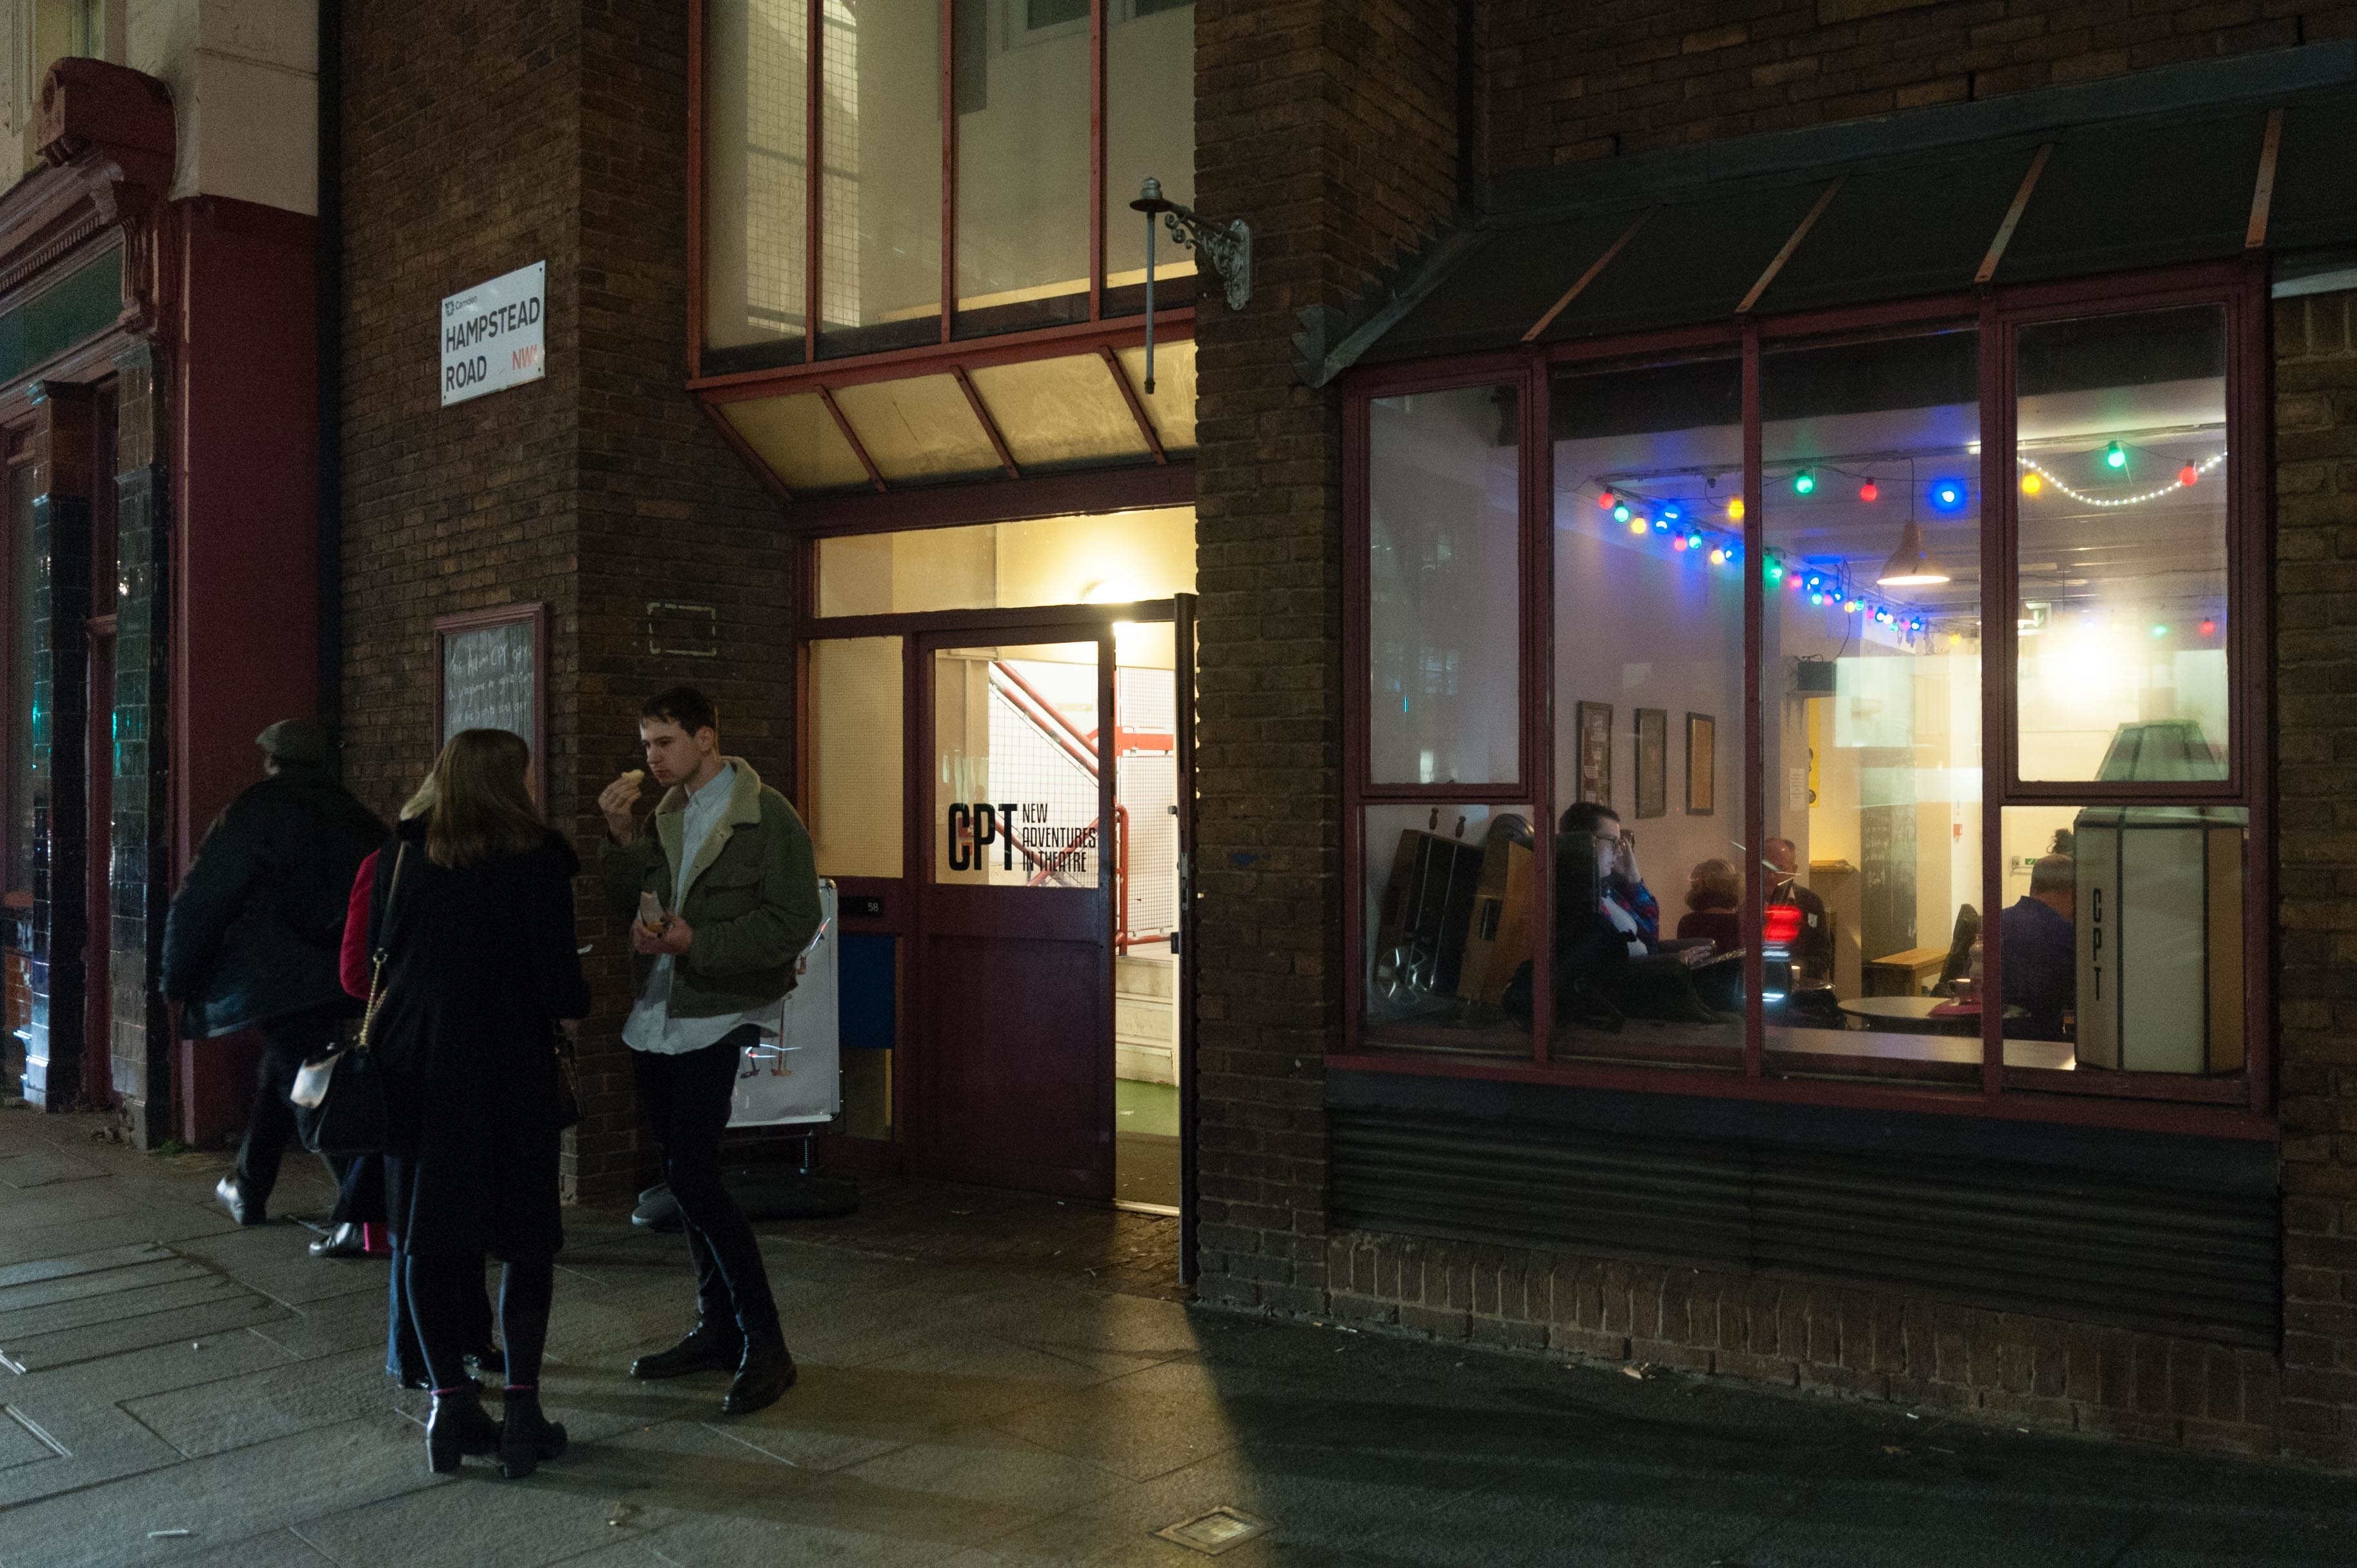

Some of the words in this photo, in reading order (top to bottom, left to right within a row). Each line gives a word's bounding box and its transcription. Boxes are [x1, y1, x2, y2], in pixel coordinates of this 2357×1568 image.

[455, 296, 478, 310] Camden
[446, 297, 540, 354] HAMPSTEAD
[446, 356, 487, 392] ROAD
[1022, 803, 1048, 823] NEW
[948, 803, 1018, 871] CPT
[1022, 827, 1096, 848] ADVENTURES
[1022, 851, 1034, 871] IN
[1038, 851, 1087, 872] THEATRE
[867, 902, 878, 912] 58
[2092, 887, 2102, 1001] CPT
